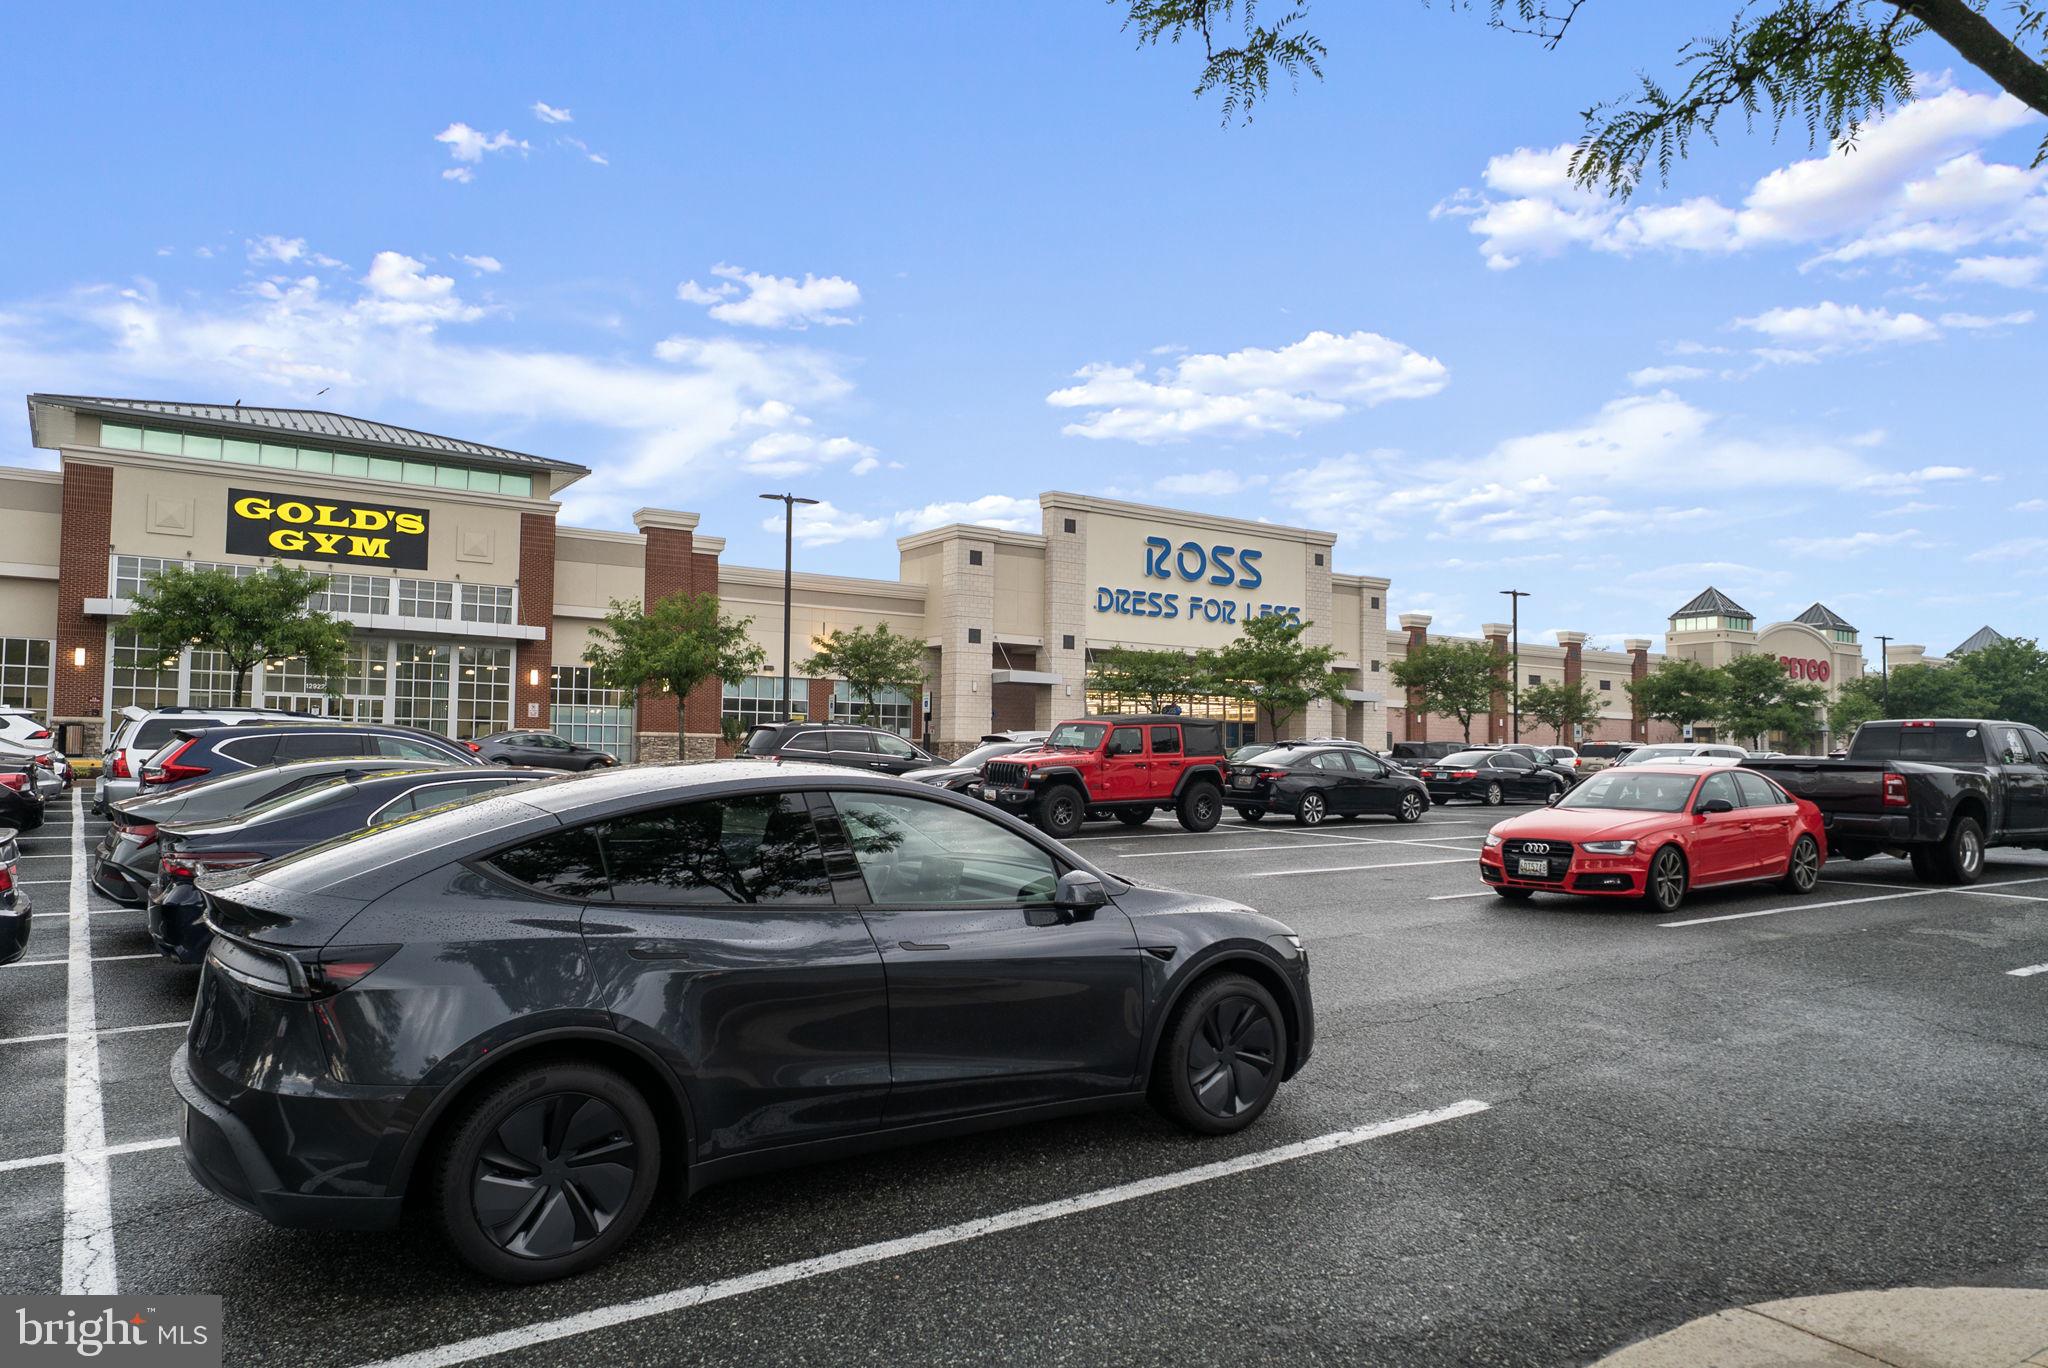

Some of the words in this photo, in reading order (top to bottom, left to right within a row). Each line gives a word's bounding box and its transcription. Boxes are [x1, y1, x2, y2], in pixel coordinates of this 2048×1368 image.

[234, 497, 426, 535] GOLD'S
[268, 529, 391, 559] GYM
[1144, 536, 1263, 589] ROSS
[1096, 587, 1179, 618] DRESS
[1188, 596, 1236, 624] FOR
